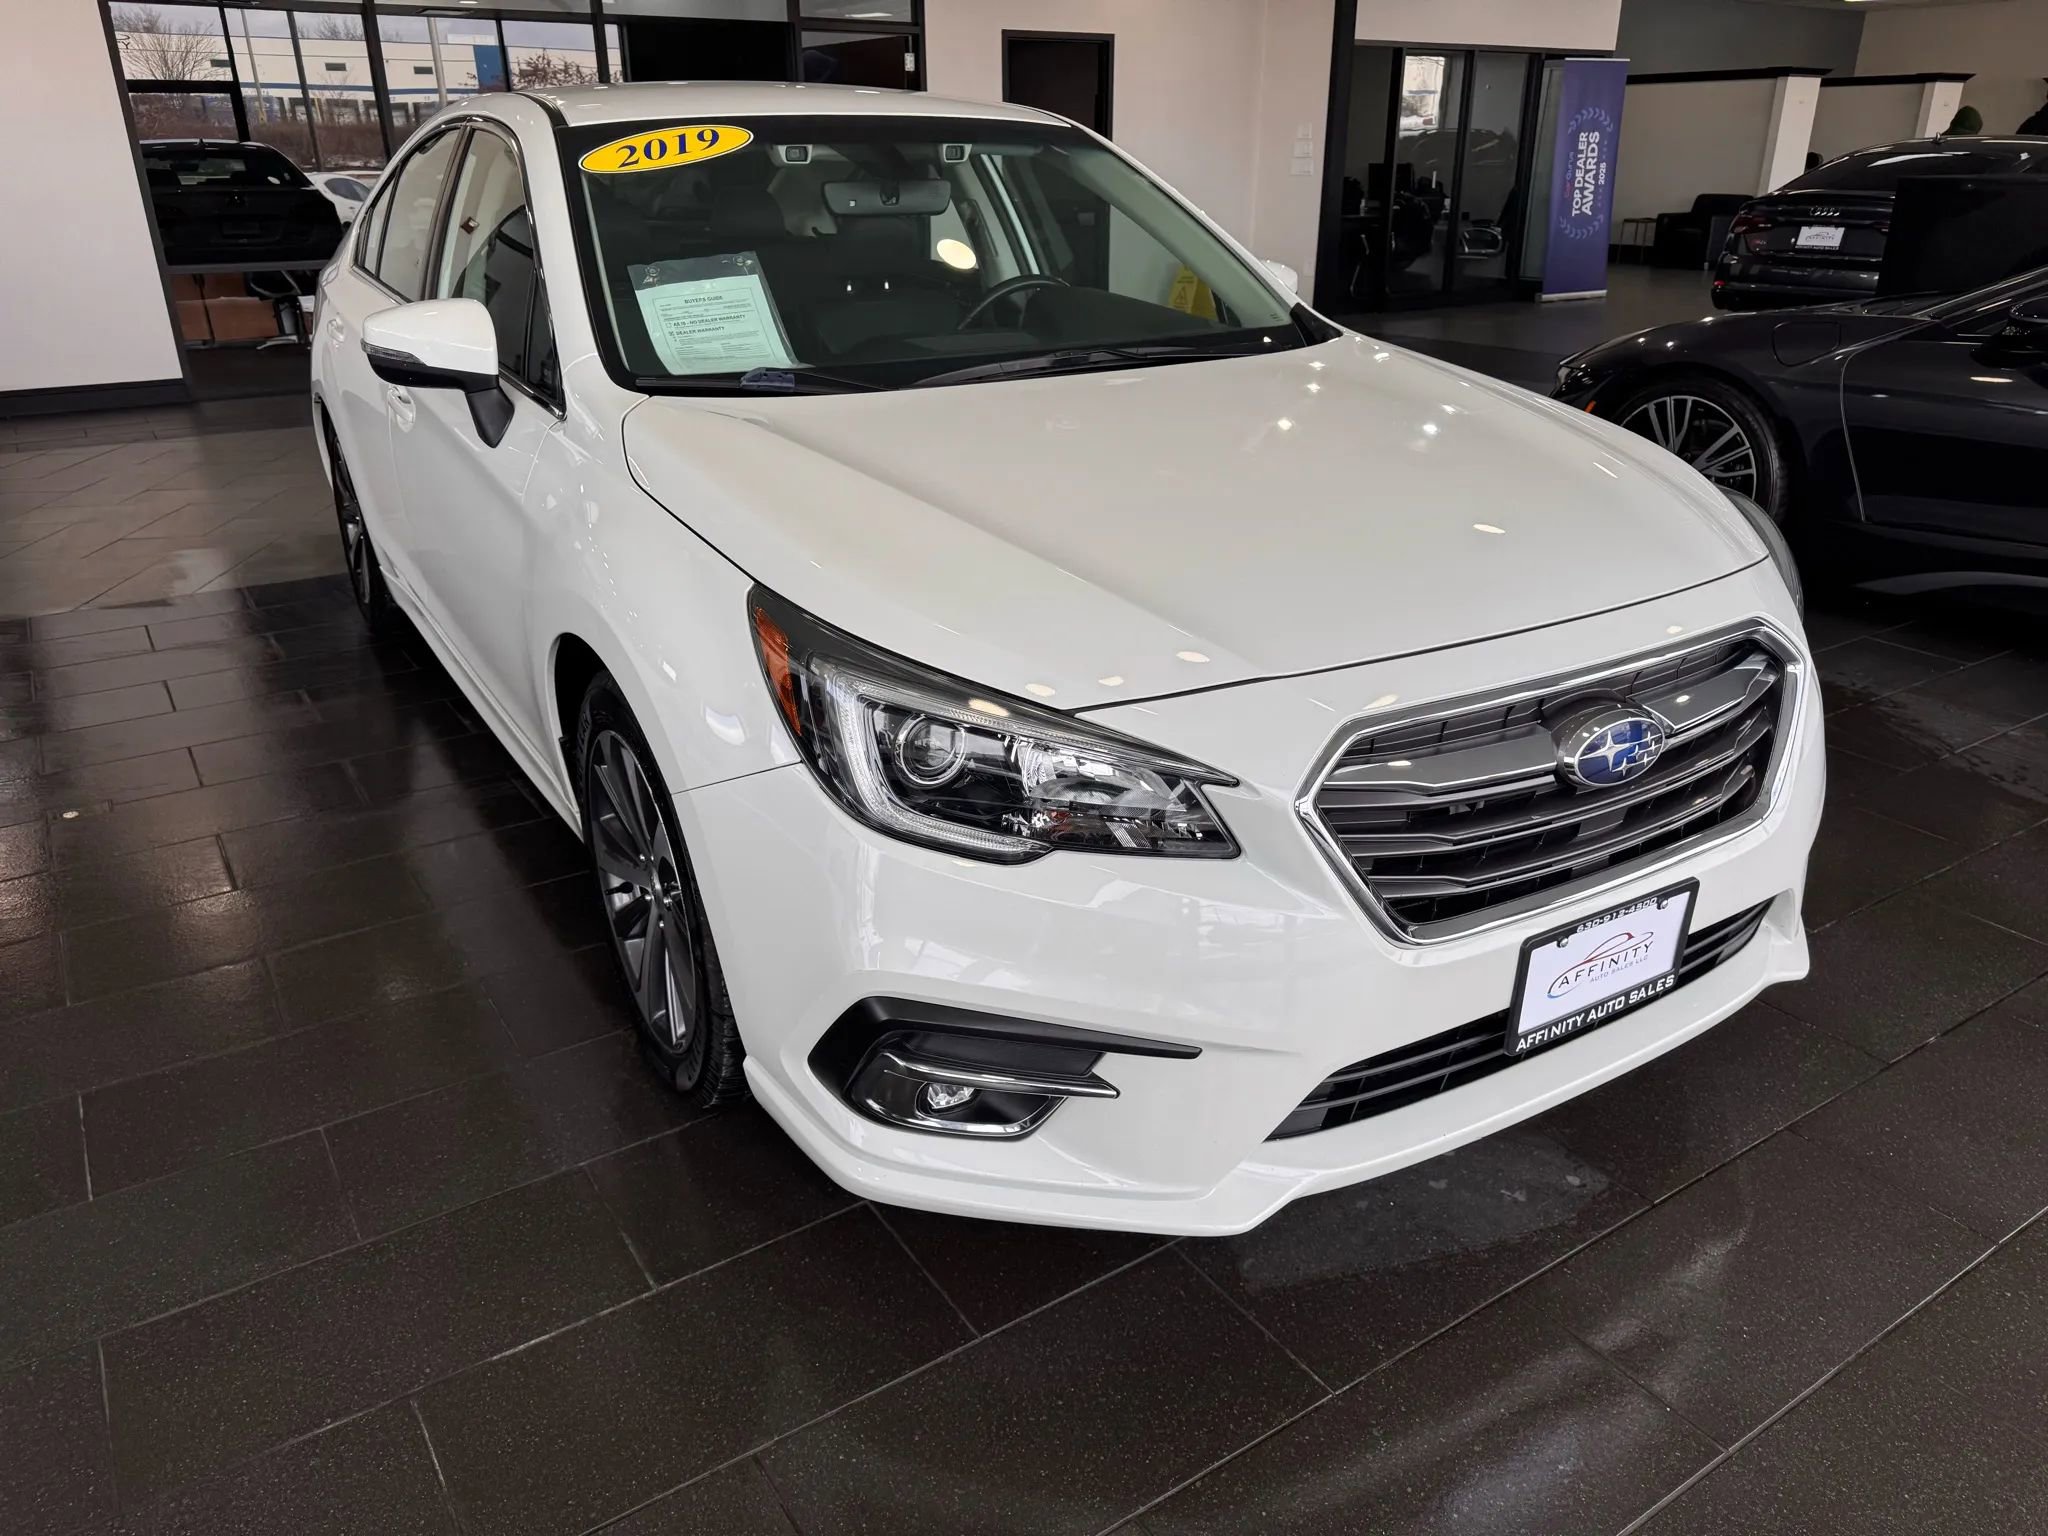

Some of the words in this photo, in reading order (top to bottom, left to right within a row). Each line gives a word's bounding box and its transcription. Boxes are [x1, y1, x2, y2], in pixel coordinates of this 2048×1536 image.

[615, 128, 720, 169] 2019
[1574, 131, 1589, 188] DEALER
[1581, 131, 1600, 216] AWARDS
[1571, 189, 1582, 216] TOP
[1557, 940, 1653, 989] AFFINITY
[1590, 971, 1609, 983] AUTO
[1611, 962, 1634, 974] SALES
[1635, 954, 1649, 964] LLC
[1515, 1013, 1585, 1052] AFFINITY
[1586, 996, 1625, 1021] AUTO
[1628, 974, 1675, 1001] SALES
